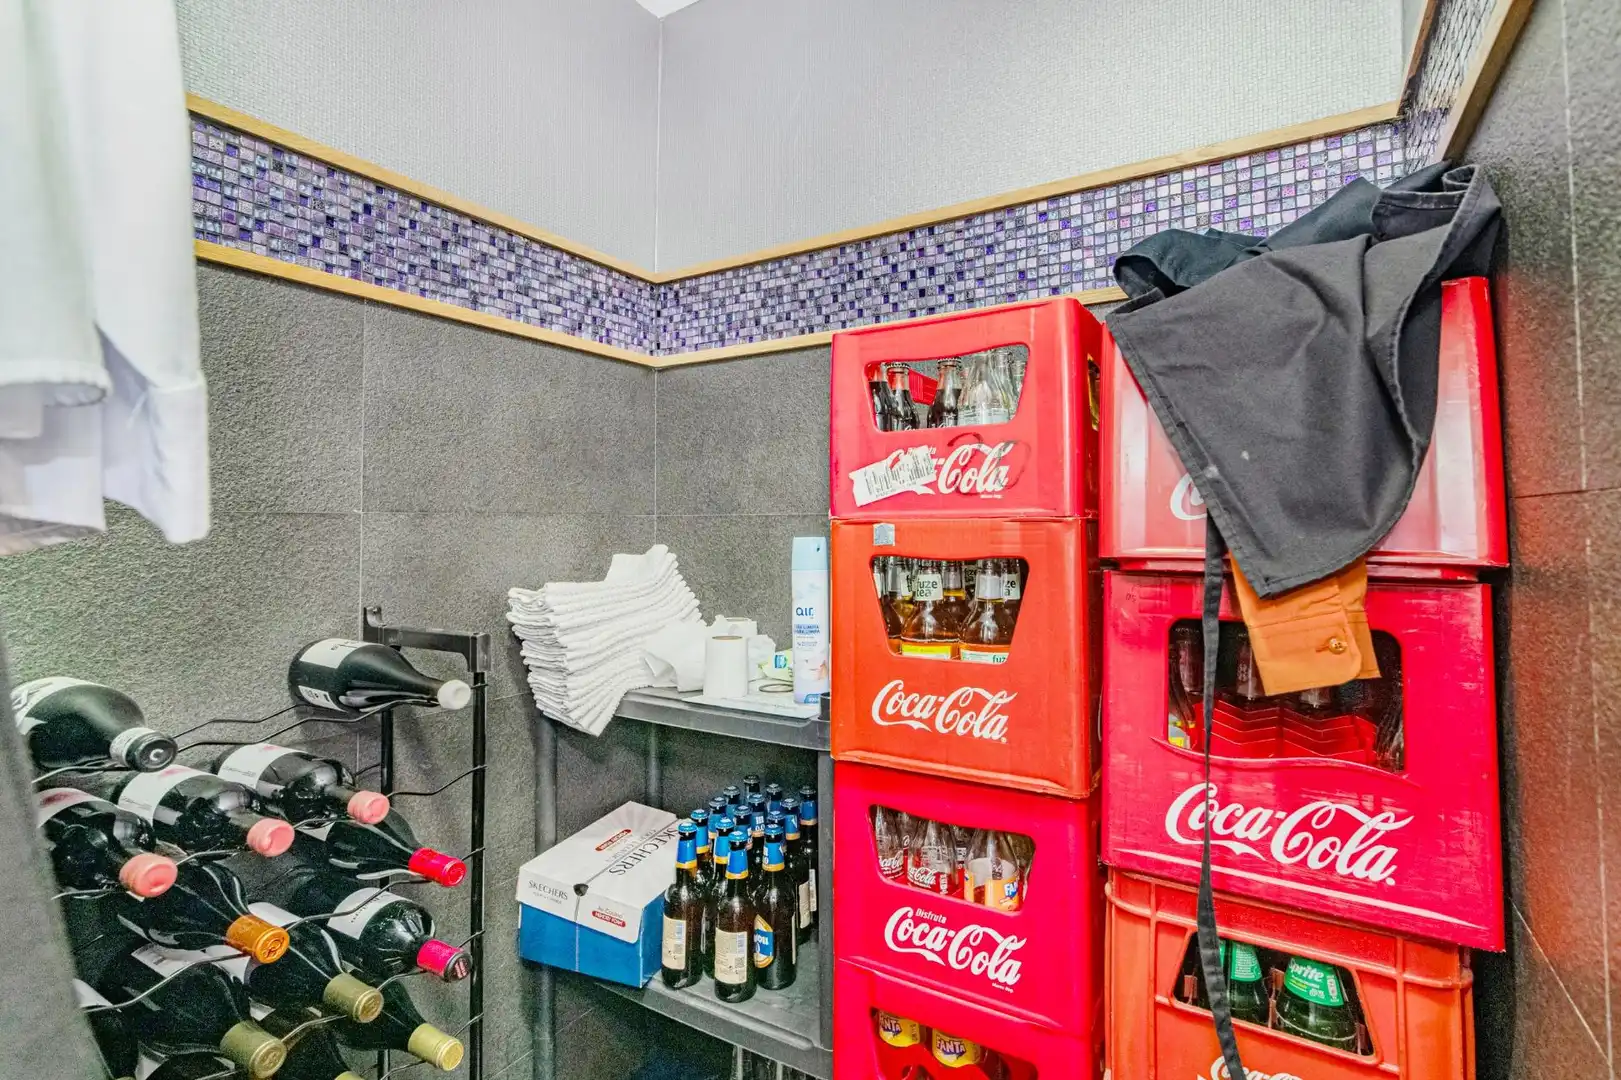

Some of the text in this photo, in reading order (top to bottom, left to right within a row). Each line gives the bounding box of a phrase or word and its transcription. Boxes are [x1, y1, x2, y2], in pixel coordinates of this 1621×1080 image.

[992, 654, 1007, 664] fuz
[871, 679, 1018, 742] Coca-Cola
[608, 827, 679, 876] SKECHERS
[1164, 782, 1415, 886] Coca-Cola
[528, 879, 569, 901] SKECHERS
[915, 907, 947, 924] Disfruta
[884, 906, 1027, 986] Coca-Cola
